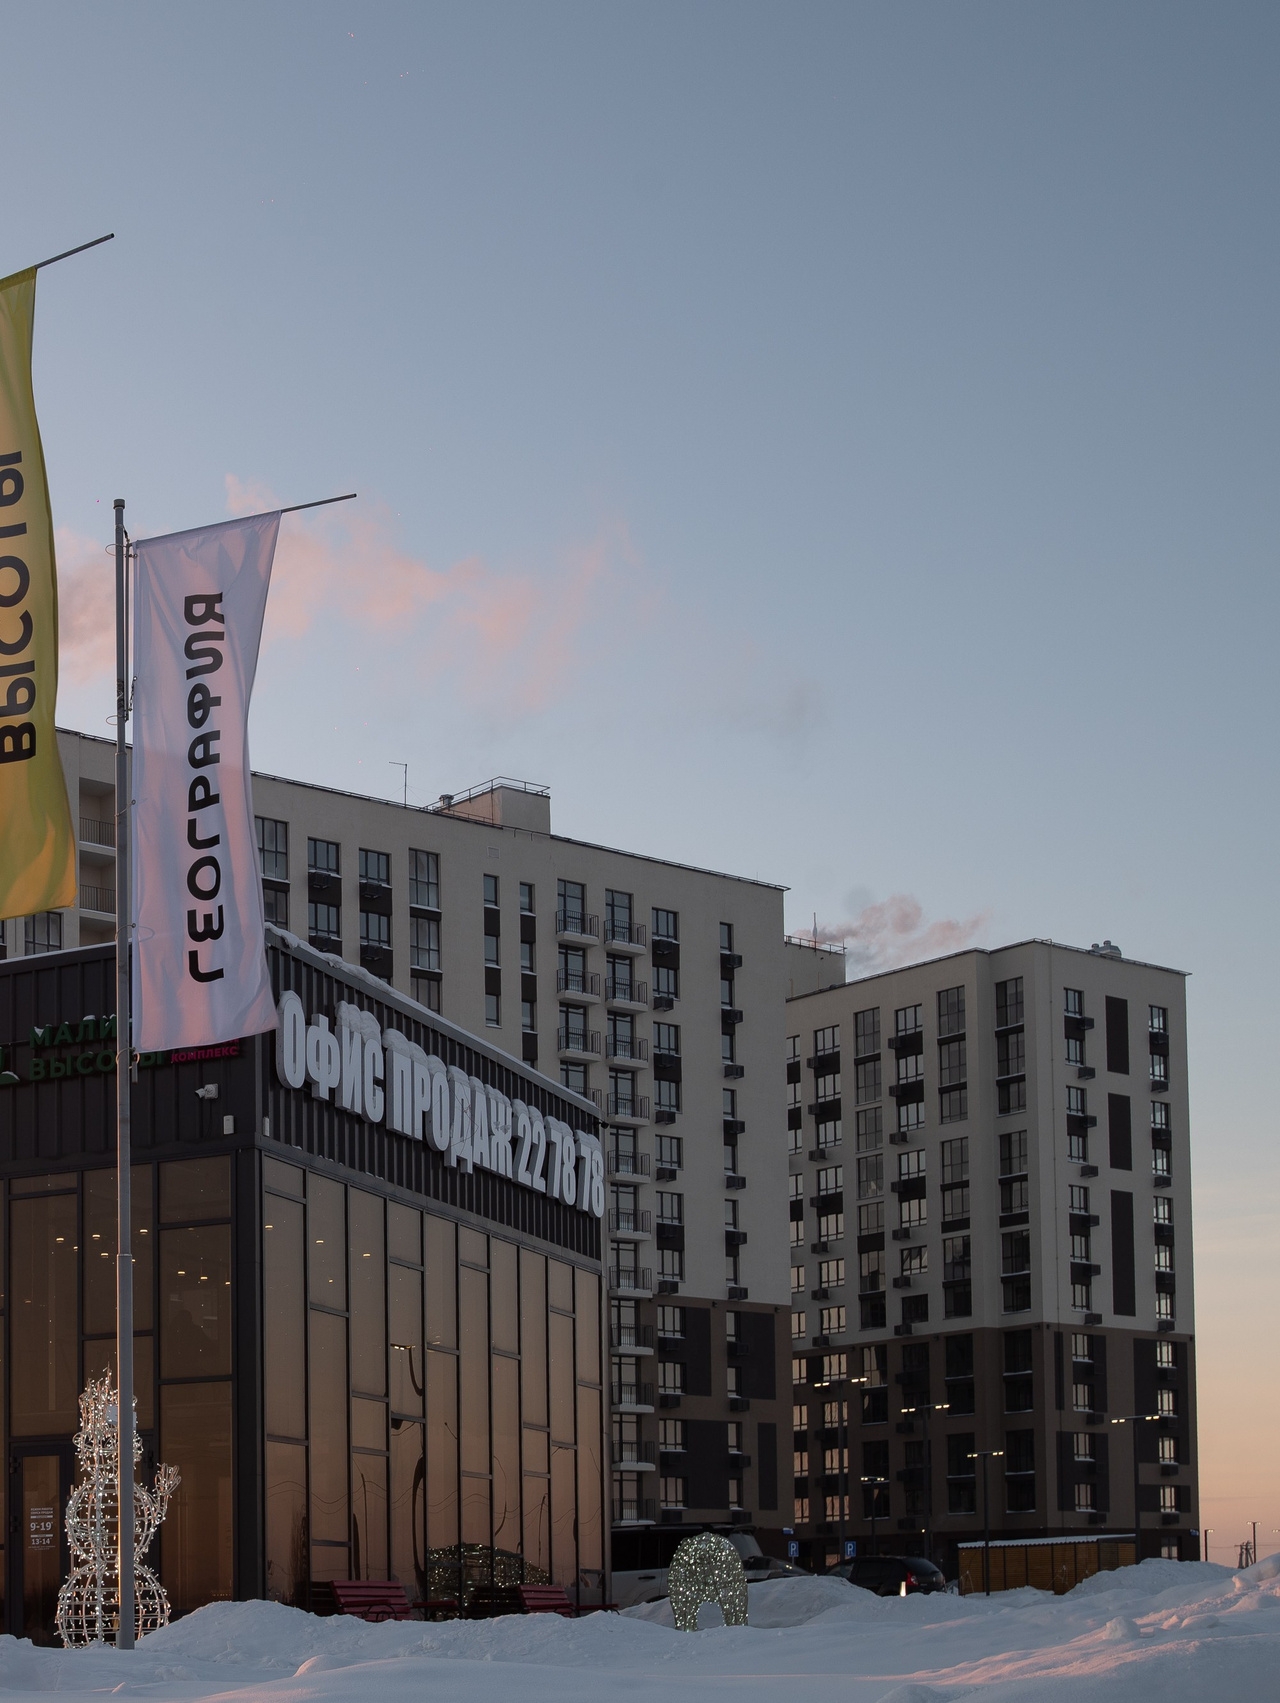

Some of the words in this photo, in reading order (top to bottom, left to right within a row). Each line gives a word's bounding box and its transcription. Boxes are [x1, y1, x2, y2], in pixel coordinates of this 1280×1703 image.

[184, 591, 225, 983] ГЕОГРАФИЯ
[30, 1048, 164, 1081] ВЫСОЫ
[171, 1046, 239, 1064] КОМПЛЕКС
[276, 996, 384, 1123] ОФИС
[386, 1044, 513, 1174] ПРОДАЖ
